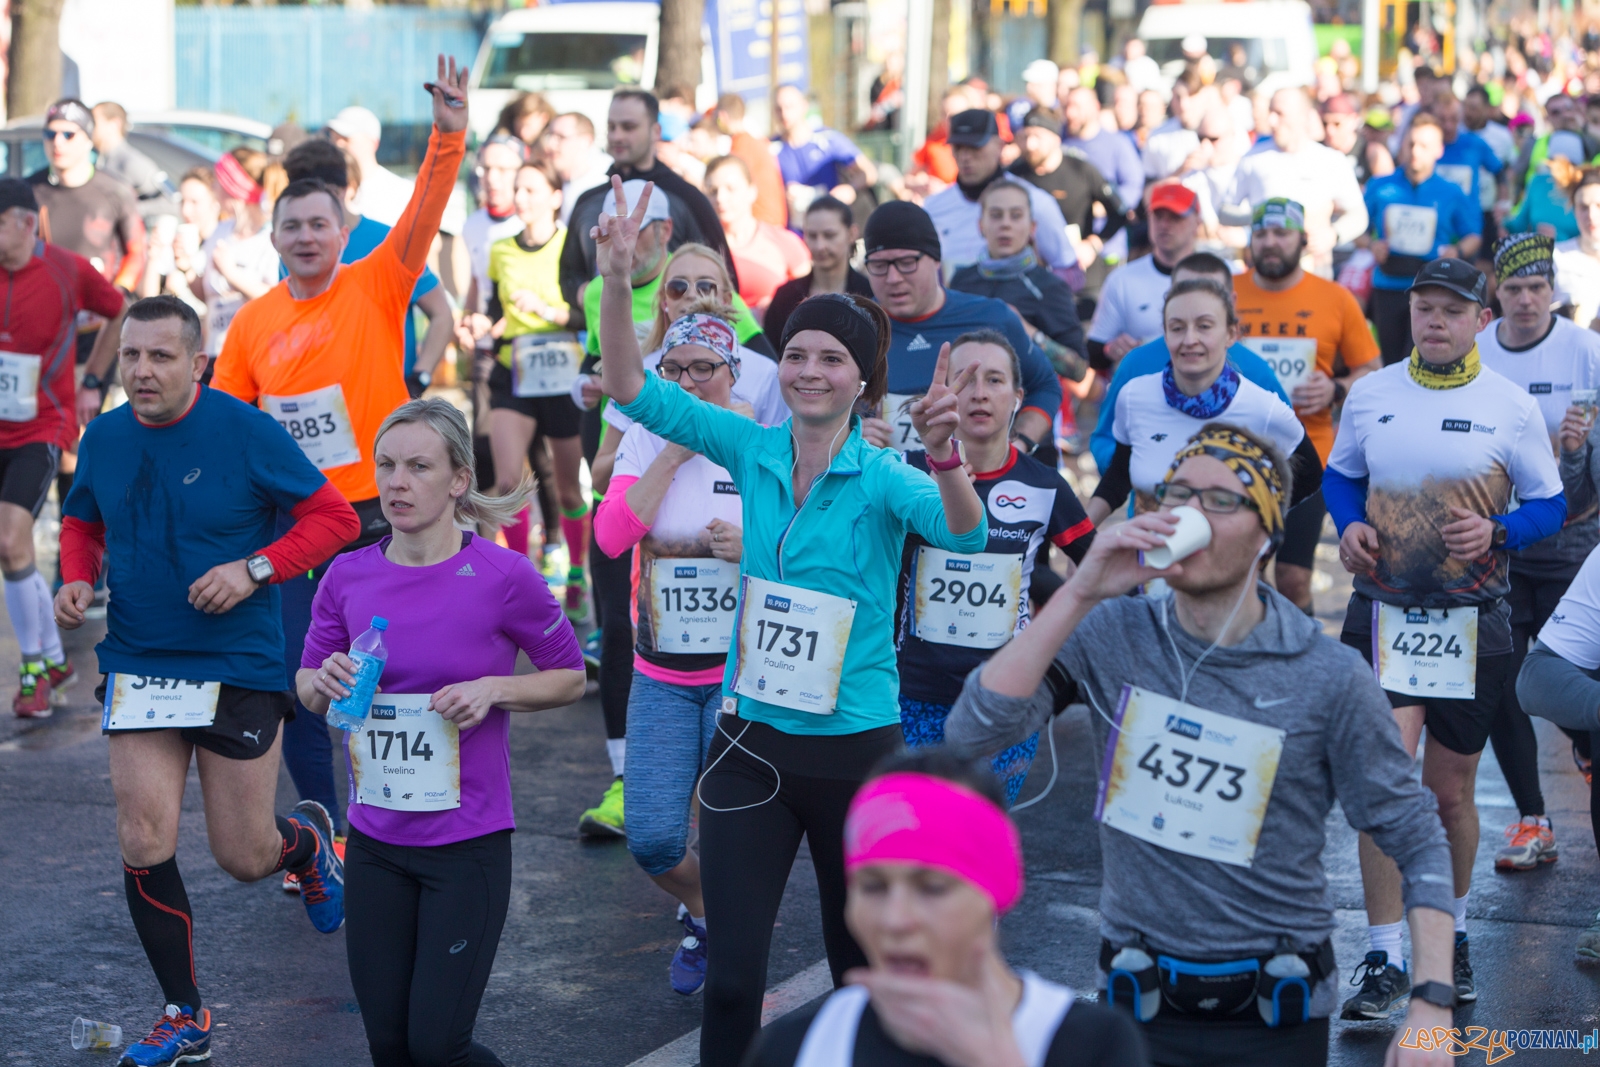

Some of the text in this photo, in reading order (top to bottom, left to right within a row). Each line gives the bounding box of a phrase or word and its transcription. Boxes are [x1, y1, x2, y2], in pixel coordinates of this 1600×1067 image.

[526, 349, 569, 369] 7183
[1377, 414, 1395, 424] 4F
[661, 587, 737, 612] 11336
[928, 577, 1007, 608] 2904
[679, 616, 718, 624] Agnieszka
[958, 609, 975, 618] Ewa
[757, 619, 819, 662] 1731
[1392, 631, 1462, 658] 4224
[764, 657, 796, 672] Paulina
[1414, 660, 1439, 668] Marcin
[367, 730, 434, 761] 1714
[383, 766, 415, 775] Ewelina
[1137, 742, 1246, 803] 4373
